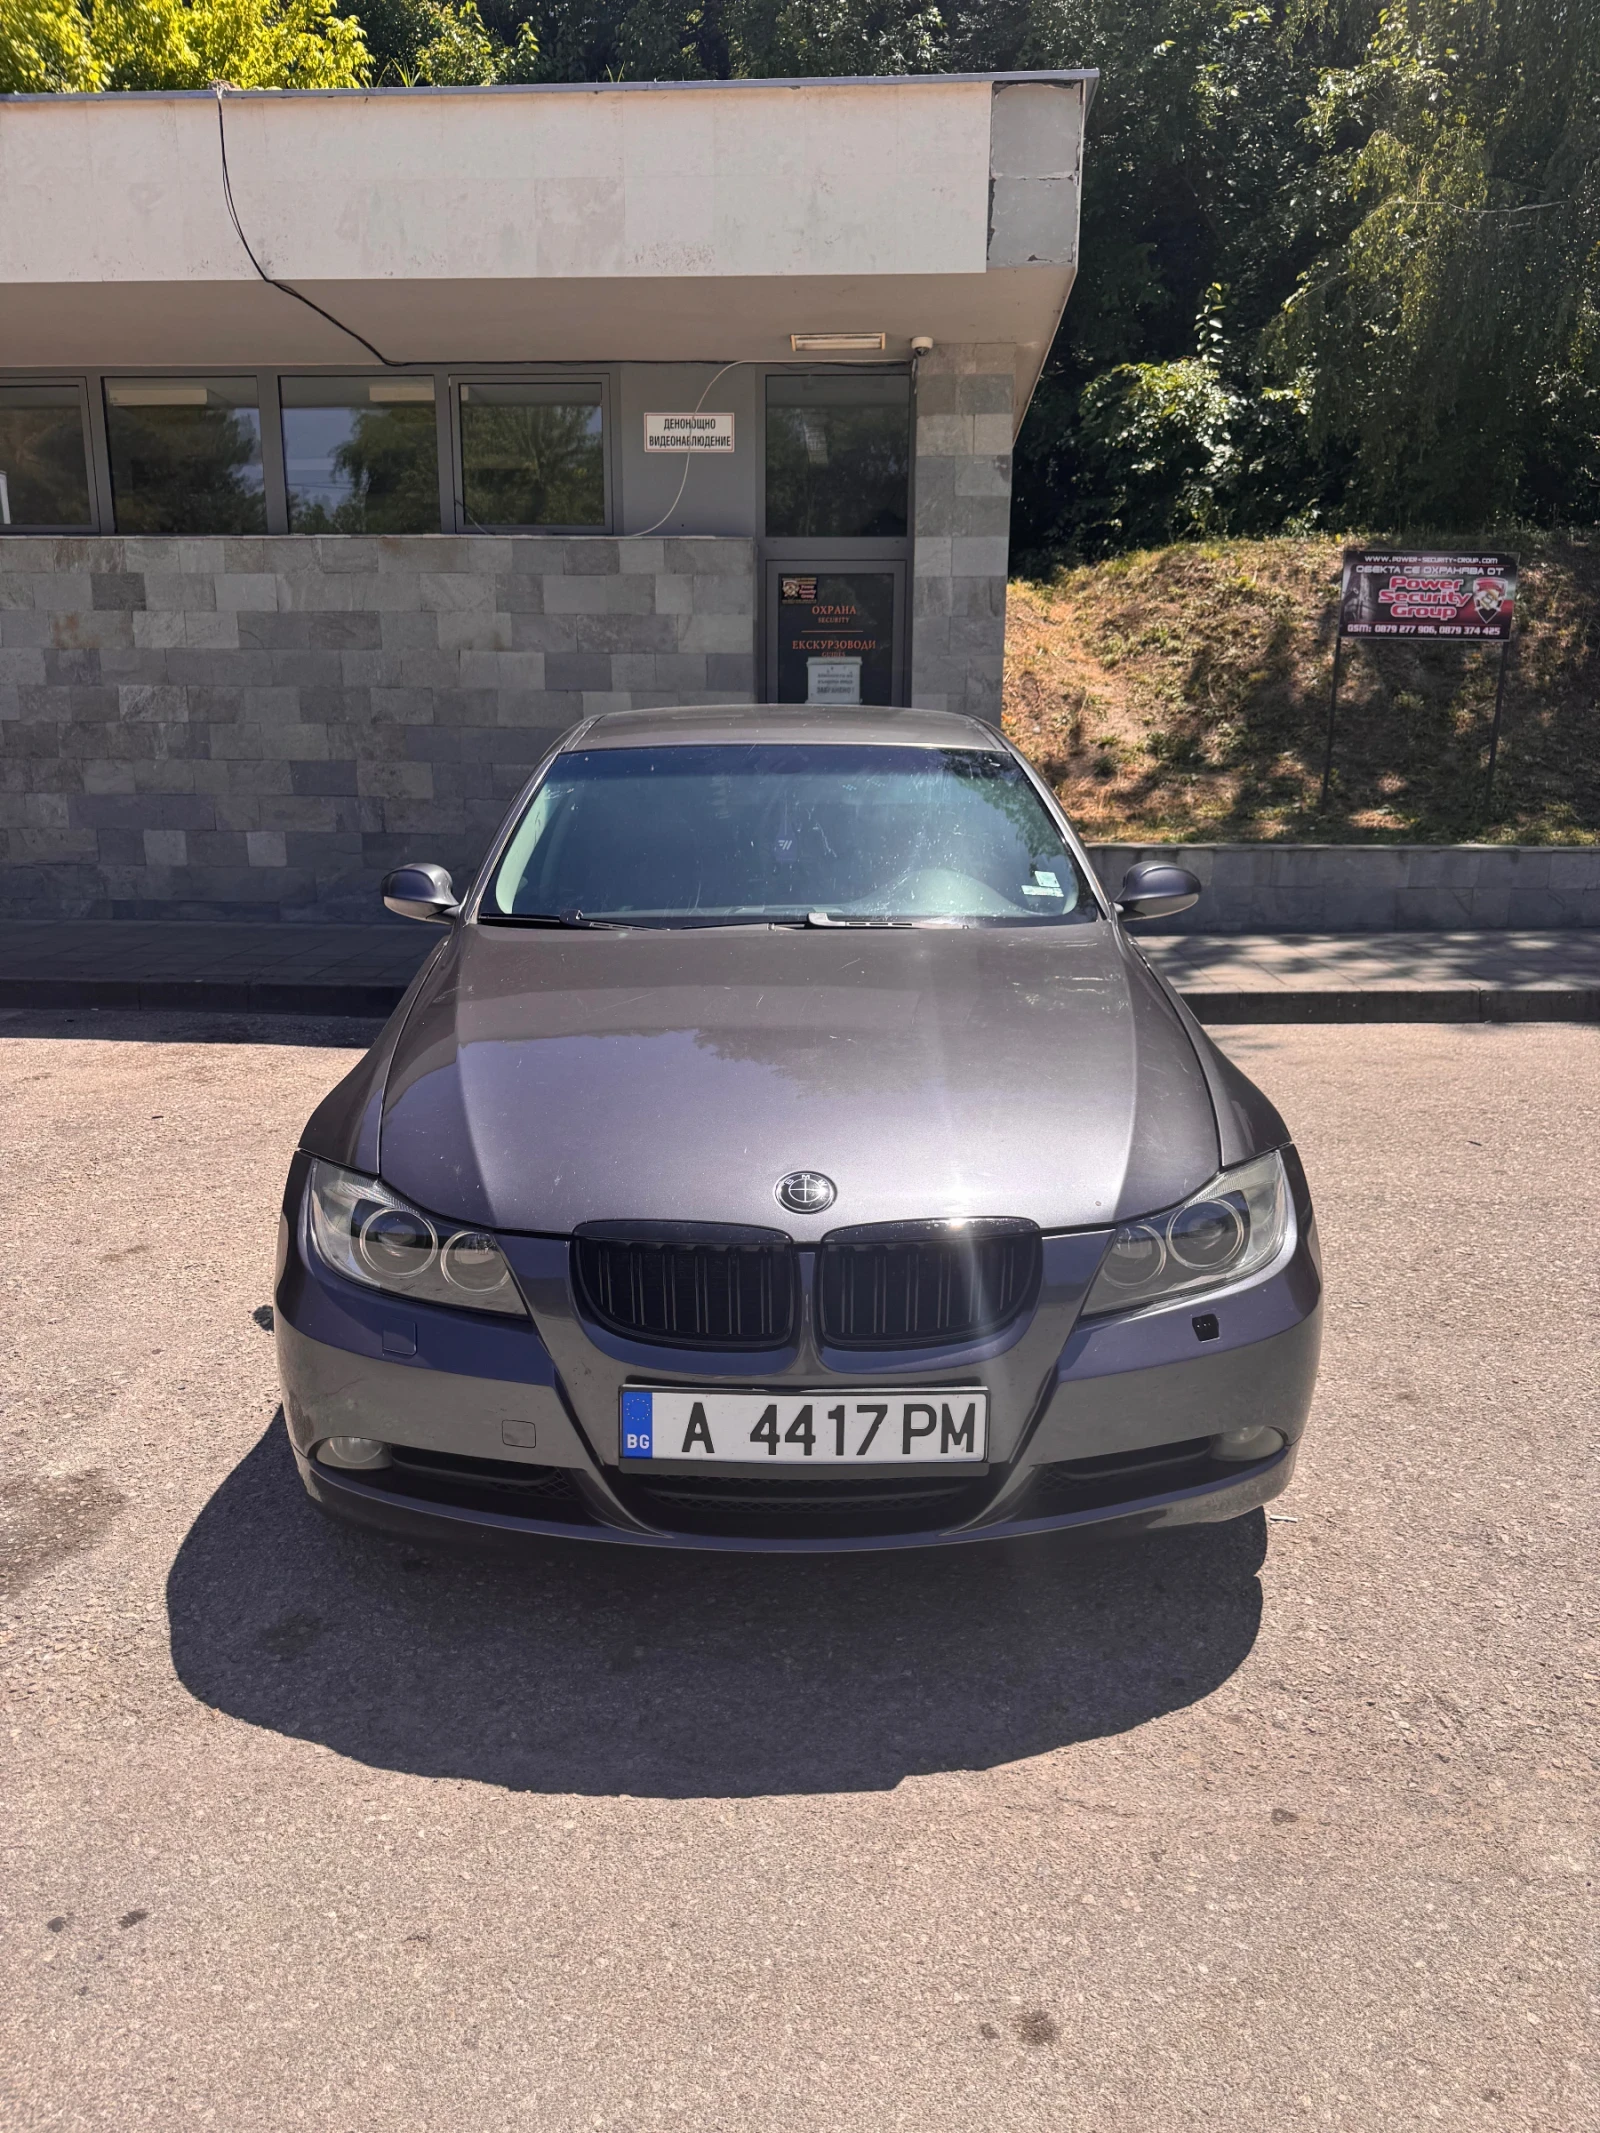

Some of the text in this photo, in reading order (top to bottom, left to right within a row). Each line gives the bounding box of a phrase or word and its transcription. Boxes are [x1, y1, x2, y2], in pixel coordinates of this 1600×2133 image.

[664, 418, 716, 431] ДЕНОНОЩНО
[649, 435, 731, 448] ВИДЕОНАБЛЮДЕНИЕ
[1356, 565, 1504, 576] ОБЕКТА СЕ ОХРАНЯВА ОТ
[1389, 576, 1464, 591] Power
[1378, 589, 1473, 607] Security
[812, 605, 857, 615] ОХРАНА
[1390, 603, 1457, 621] Group
[1374, 625, 1397, 633] 0879
[1399, 625, 1416, 633] 277
[1439, 626, 1461, 634] 0879
[1463, 626, 1481, 635] 374
[1482, 626, 1500, 636] 425
[792, 640, 876, 650] ЕКСКУРЗОВОДИ
[681, 1401, 715, 1454] A
[749, 1404, 889, 1456] 4417
[626, 1434, 650, 1450] BG
